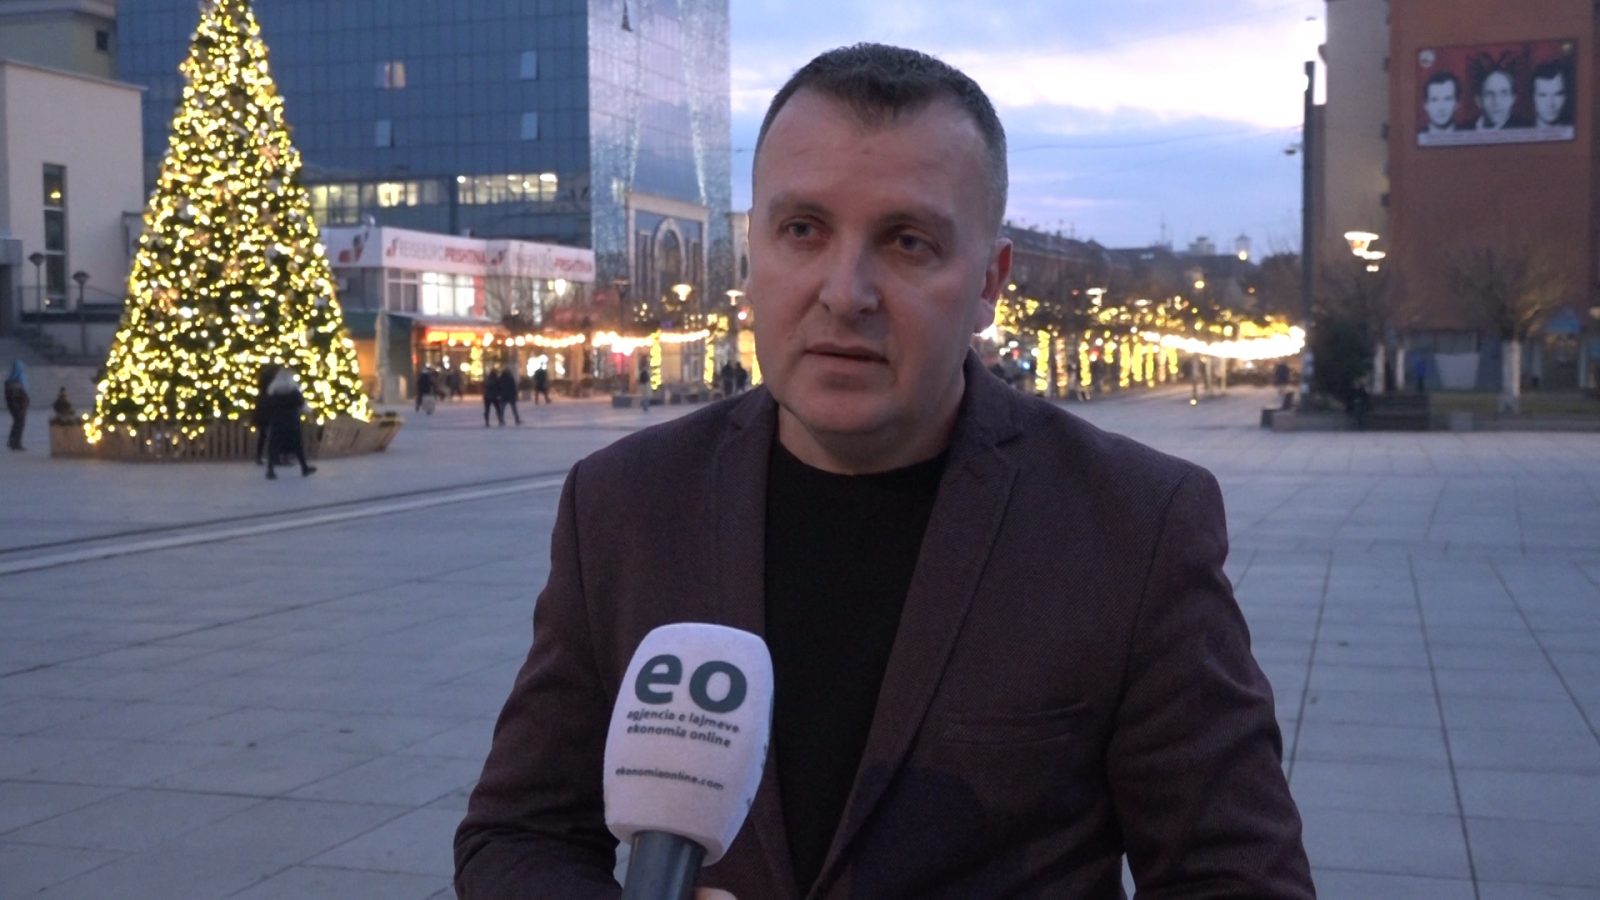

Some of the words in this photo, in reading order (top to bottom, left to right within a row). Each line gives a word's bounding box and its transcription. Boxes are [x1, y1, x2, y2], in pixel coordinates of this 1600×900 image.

[634, 654, 748, 714] eo
[626, 708, 675, 722] agjencia
[678, 713, 686, 722] e
[689, 713, 740, 733] lajmeve
[626, 723, 687, 738] ekonomia
[690, 729, 731, 748] online
[615, 766, 724, 790] ekonomiaonline.com
